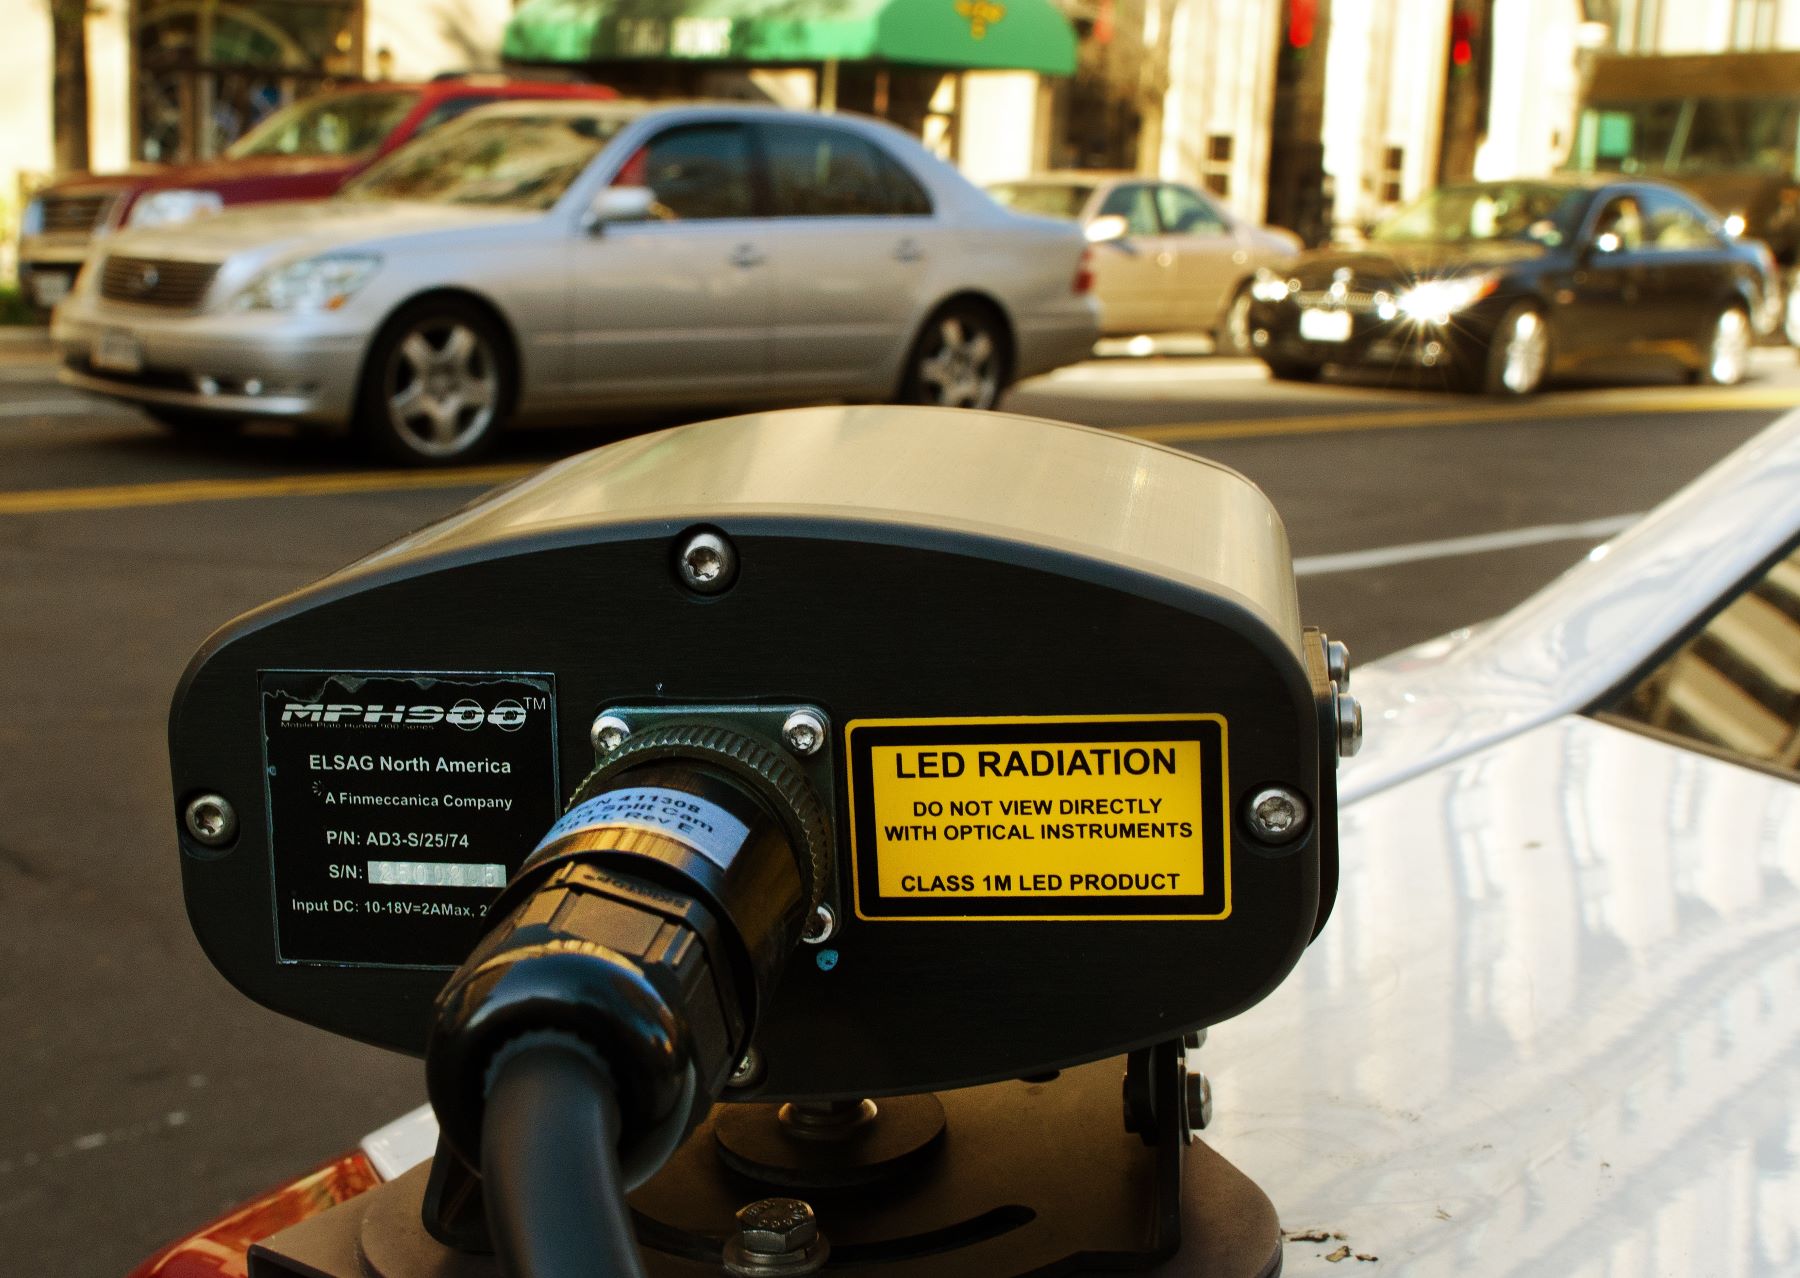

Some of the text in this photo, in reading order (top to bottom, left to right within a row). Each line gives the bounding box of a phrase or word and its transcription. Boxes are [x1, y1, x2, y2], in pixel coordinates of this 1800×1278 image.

[310, 755, 511, 773] ELSAG North America
[896, 748, 1176, 779] LED RADIATION
[326, 792, 512, 810] A Finmeccanica Company
[619, 795, 700, 814] 411308
[913, 798, 1163, 817] DO NOT VIEW DIRECTLY
[603, 803, 714, 833] Split Cam
[625, 812, 671, 824] Rev
[677, 823, 694, 834] E
[326, 831, 469, 848] P/N: AD3-S/25/74
[885, 822, 1193, 841] WITH OPTICAL INSTRUMENTS
[329, 864, 362, 879] S/N:
[901, 873, 1180, 892] CLASS 1M LED PRODUCT
[292, 898, 328, 912] Input
[333, 900, 359, 912] DC:
[480, 904, 490, 918] 2
